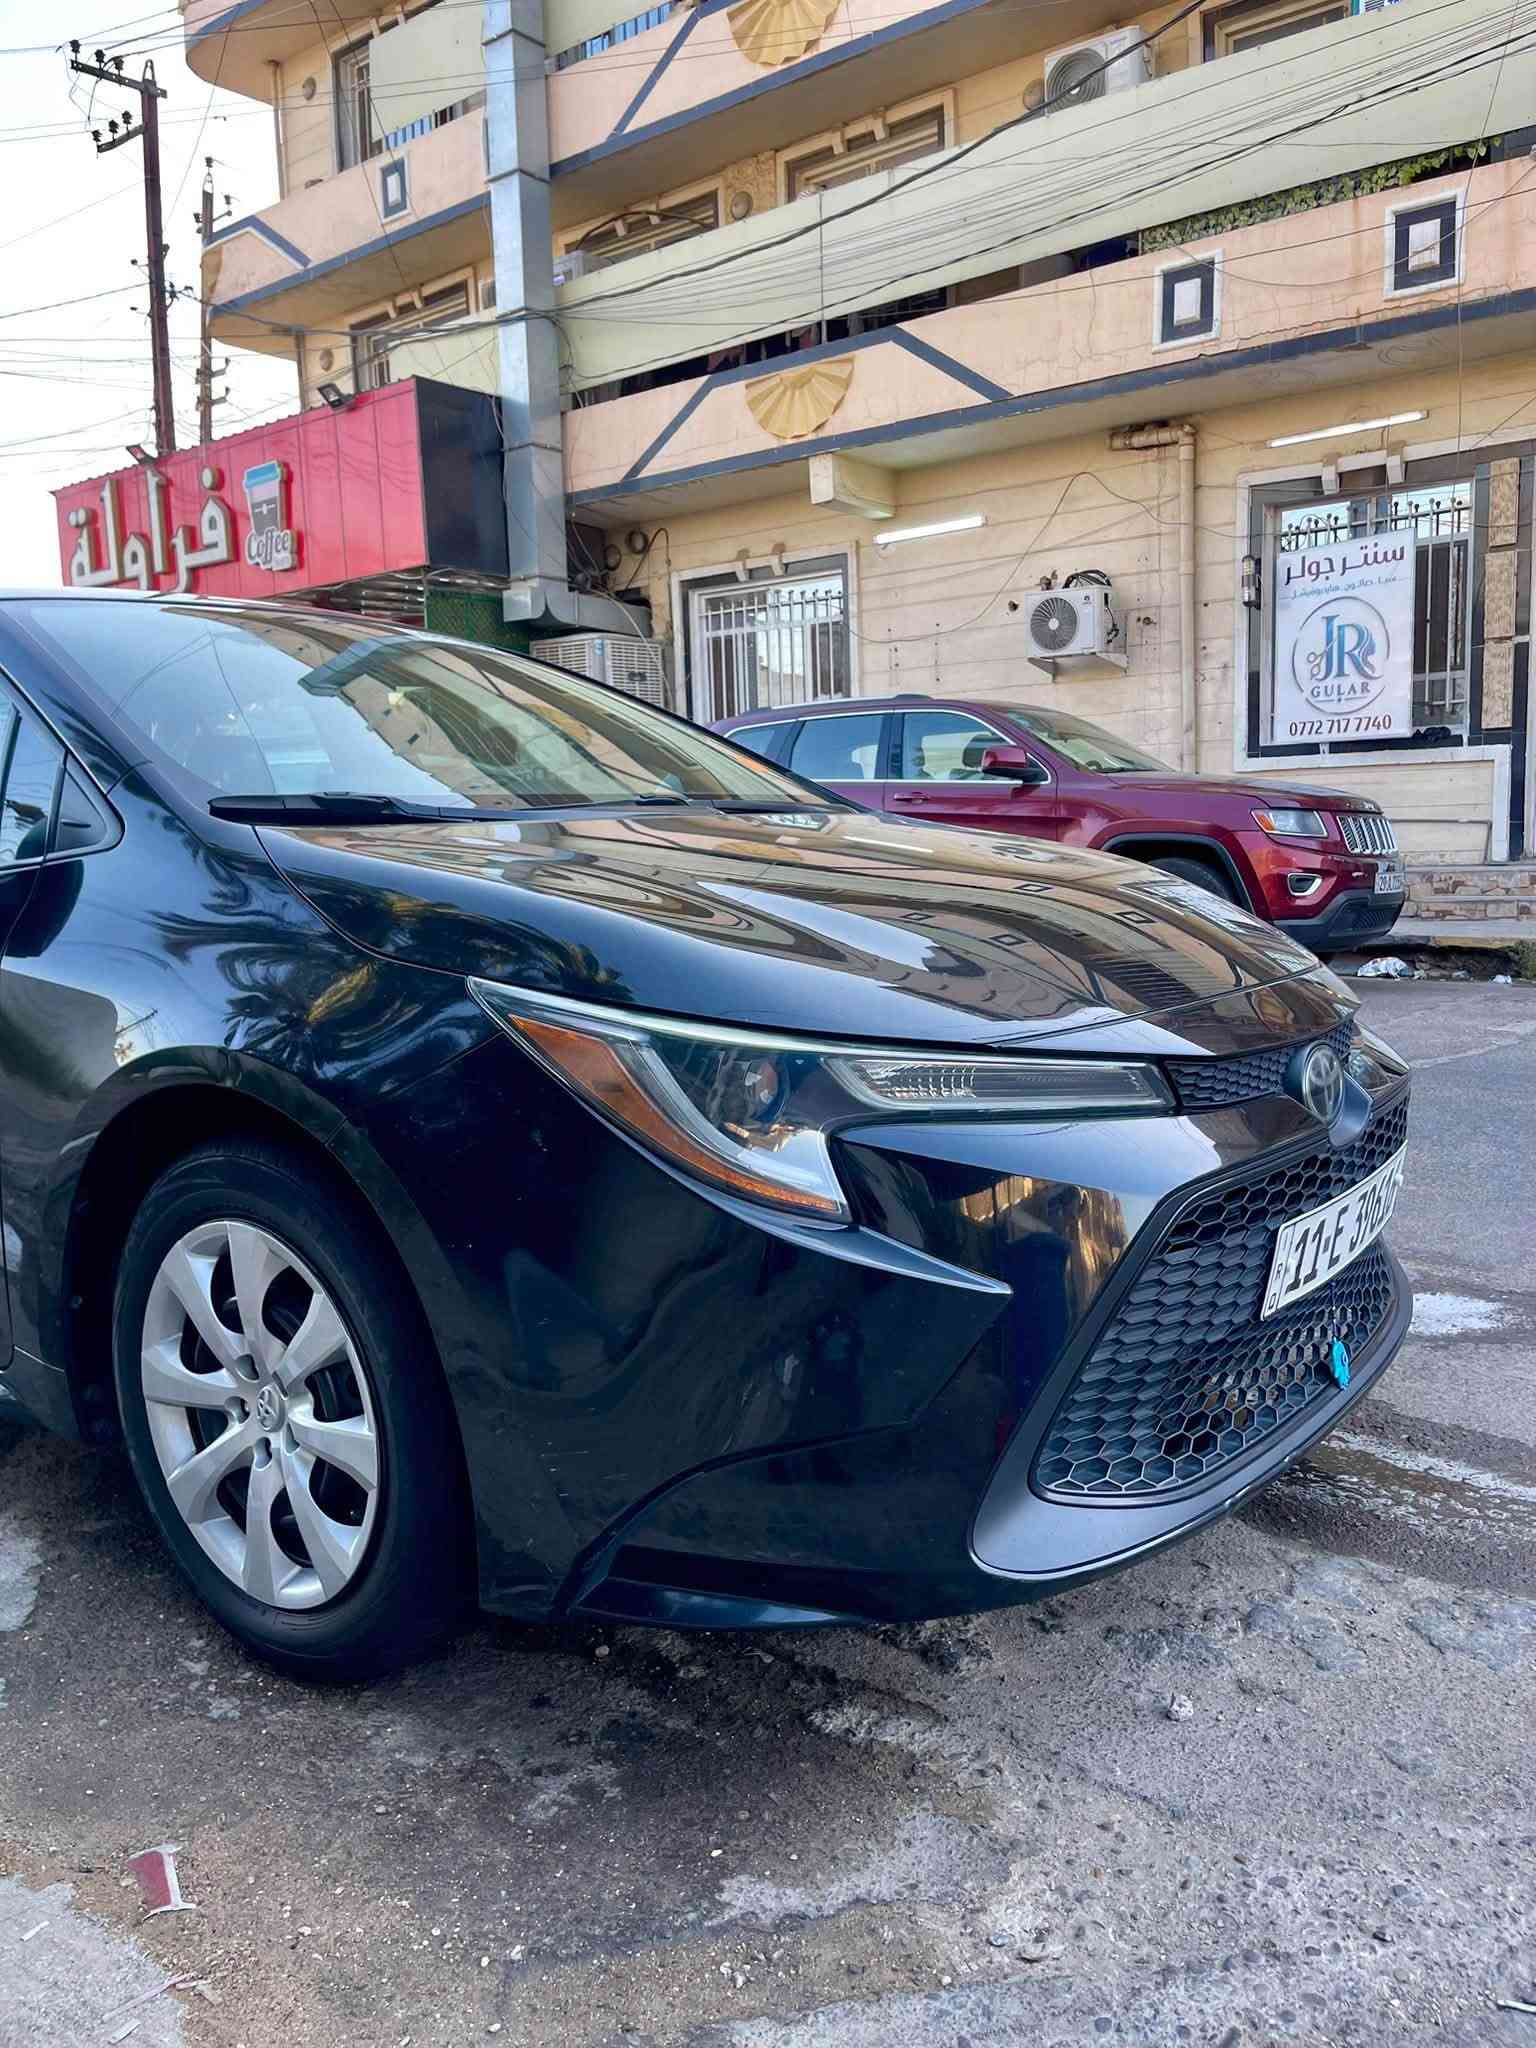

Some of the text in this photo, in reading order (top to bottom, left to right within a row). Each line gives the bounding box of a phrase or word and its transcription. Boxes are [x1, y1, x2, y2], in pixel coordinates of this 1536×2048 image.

[68, 465, 235, 593] فراولة
[247, 527, 290, 565] Coffee
[1284, 541, 1405, 586] سنتر جولر
[1310, 681, 1371, 698] GULAR
[1289, 713, 1392, 737] 0772 717 7740
